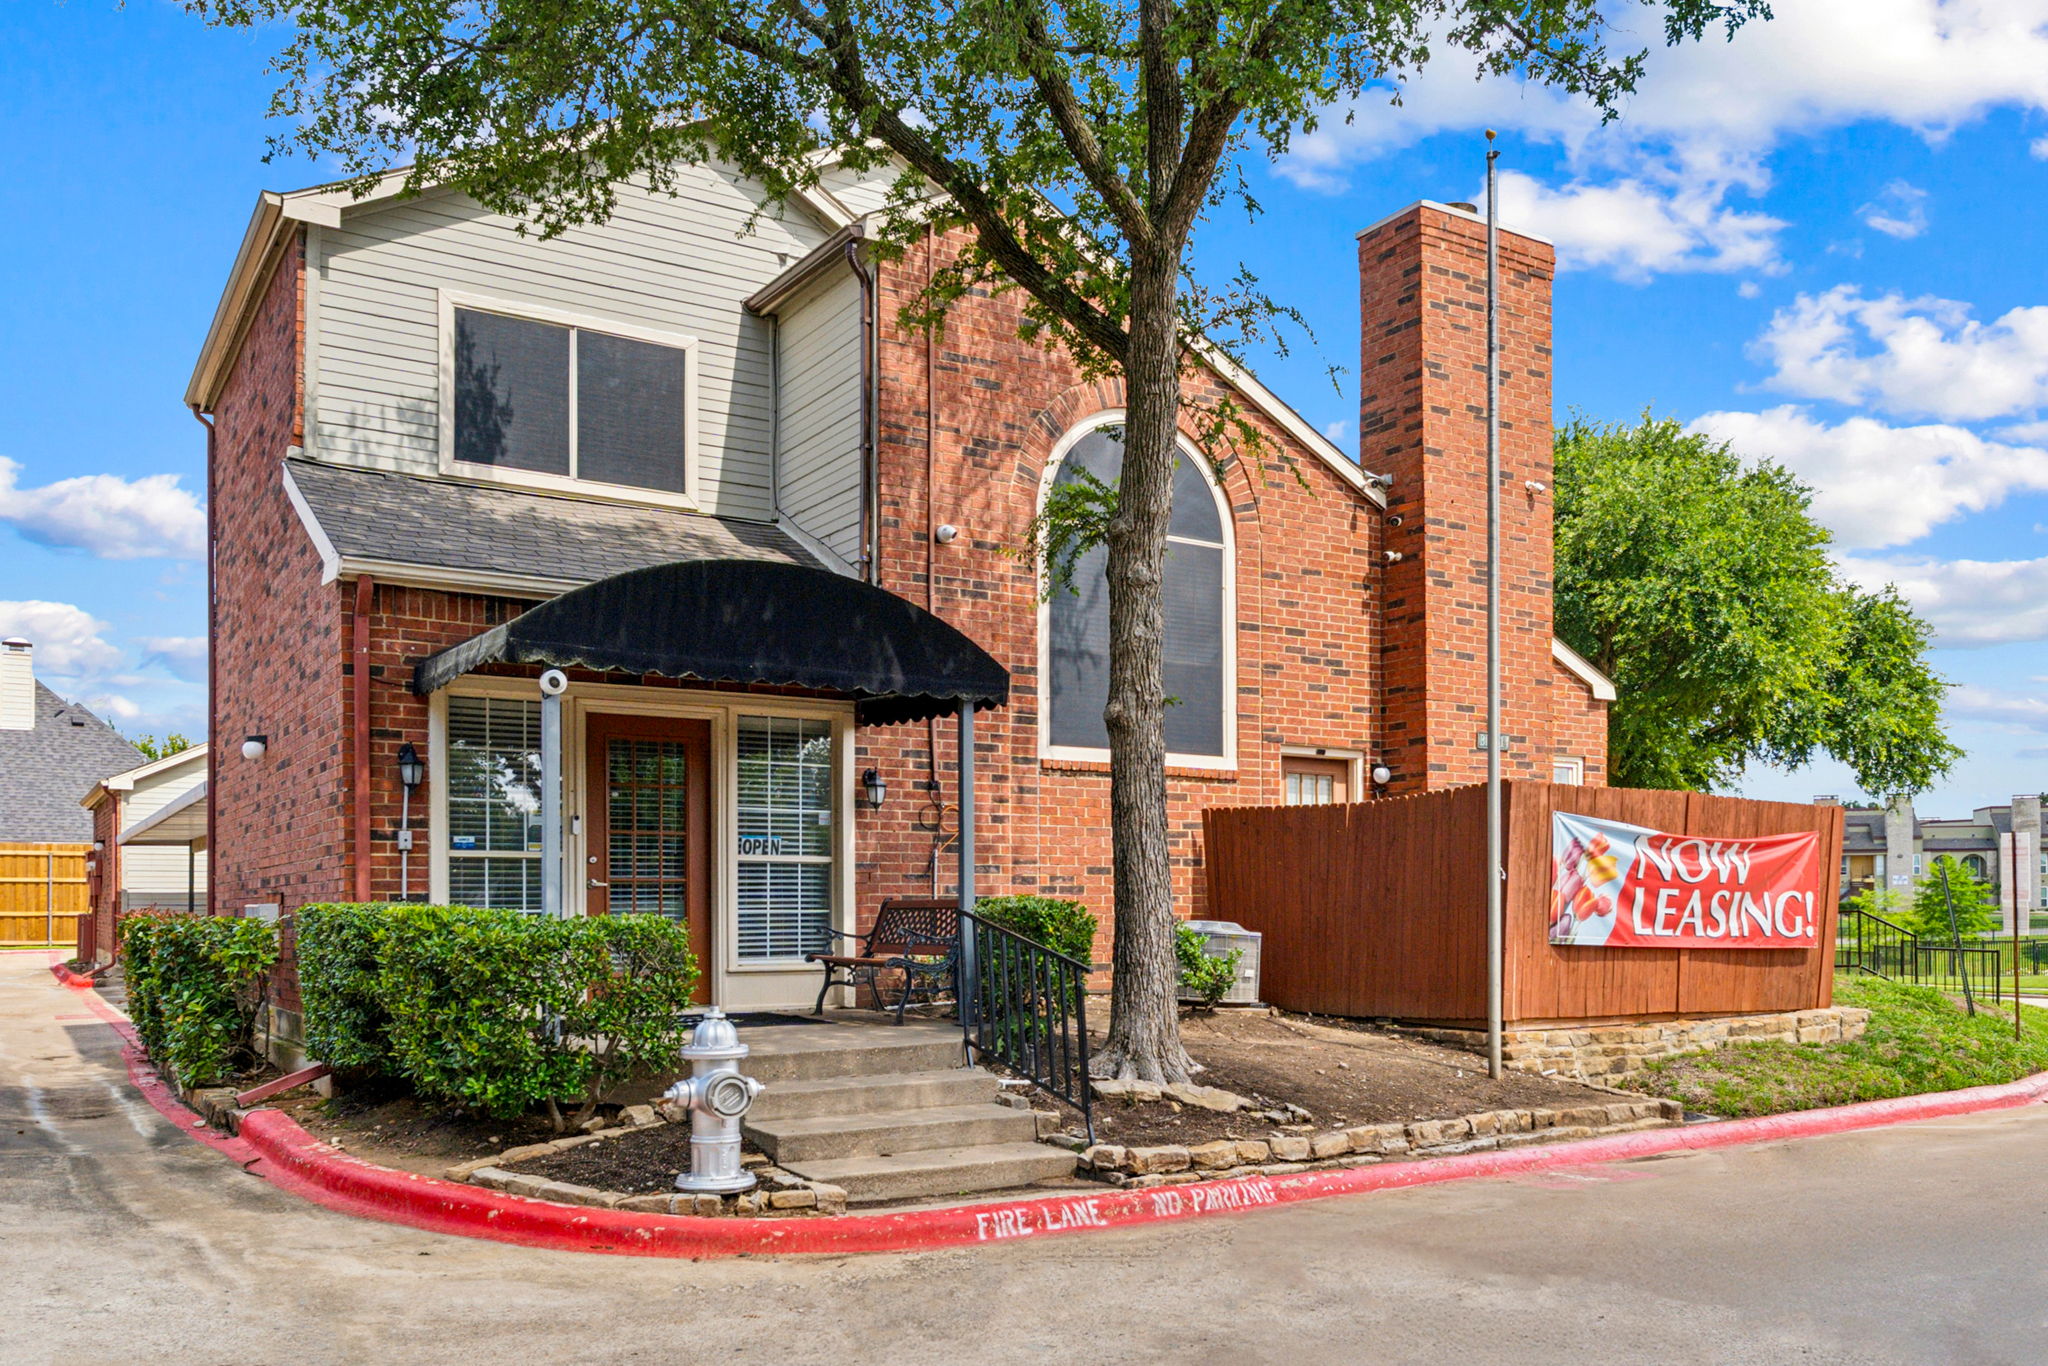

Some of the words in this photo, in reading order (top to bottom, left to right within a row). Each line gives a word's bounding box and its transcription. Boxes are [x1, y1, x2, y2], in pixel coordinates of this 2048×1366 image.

[742, 838, 780, 855] OPEN
[1635, 835, 1755, 884] NOW
[1632, 887, 1814, 938] LEASING!
[976, 1211, 1034, 1240] FIRE
[1043, 1199, 1108, 1230] LANE
[1151, 1191, 1182, 1217] NO
[1189, 1180, 1278, 1213] PARKING
